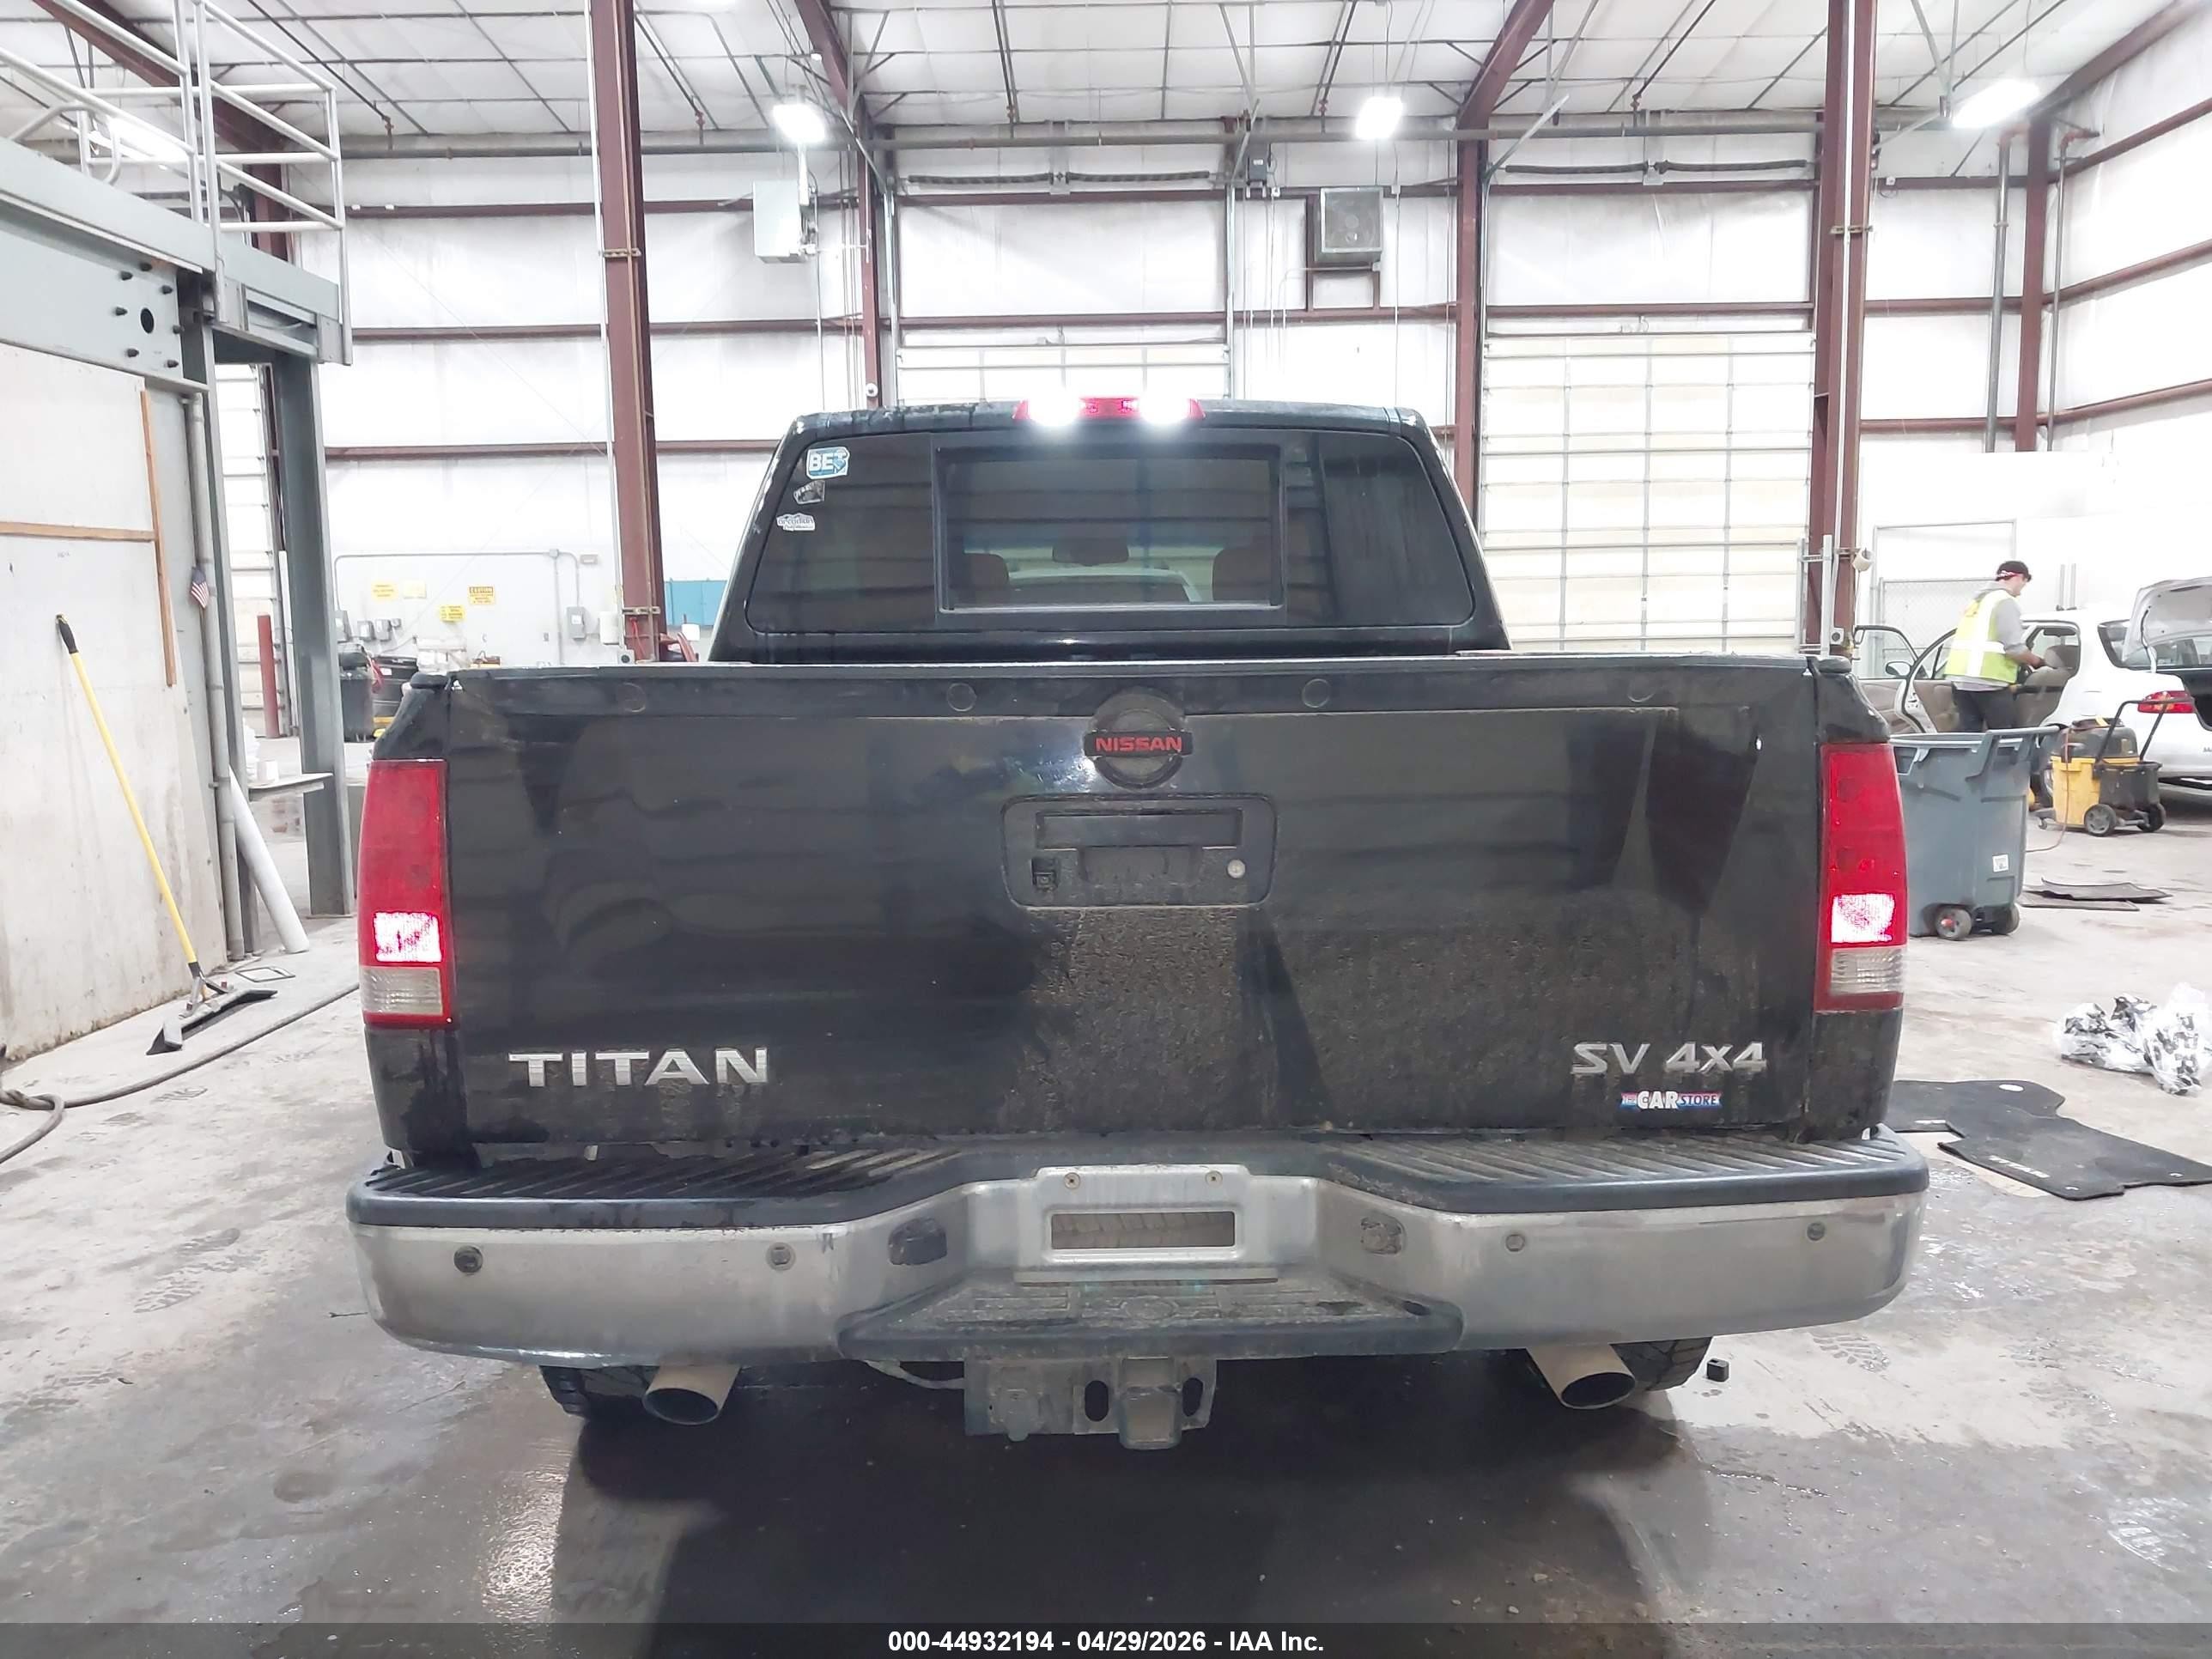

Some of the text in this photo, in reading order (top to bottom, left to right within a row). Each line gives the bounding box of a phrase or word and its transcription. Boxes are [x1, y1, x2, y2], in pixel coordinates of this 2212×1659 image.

[1096, 737, 1182, 752] NISSAN
[508, 1047, 769, 1087] TITAN
[1571, 1042, 1650, 1074] SV
[1638, 1091, 1679, 1109] CAR
[1680, 1094, 1717, 1106] STORE
